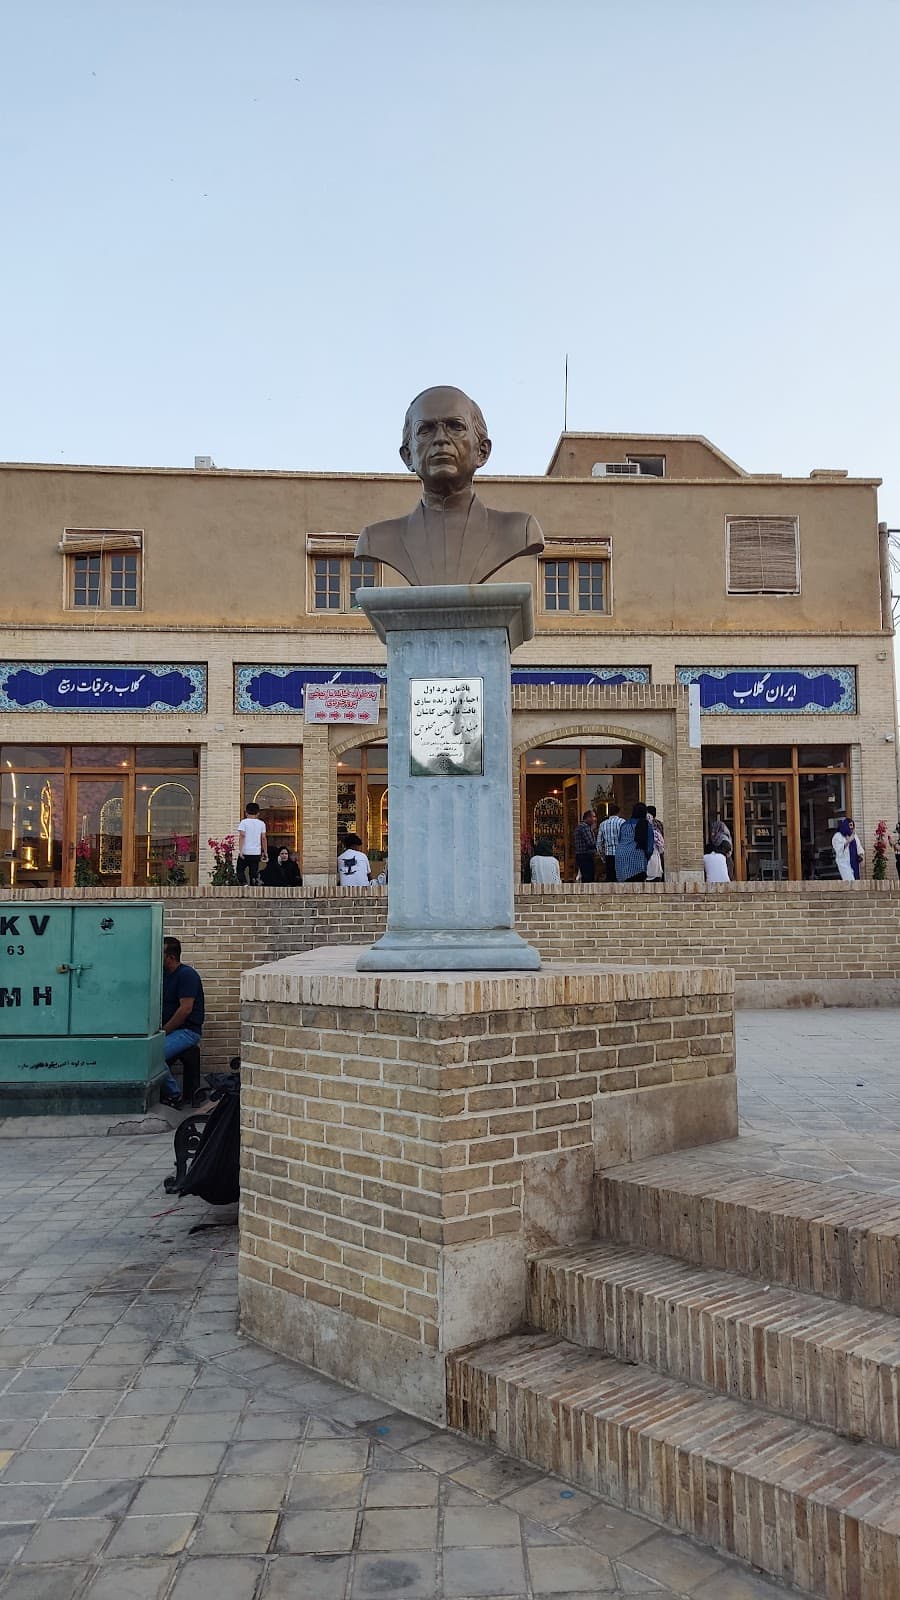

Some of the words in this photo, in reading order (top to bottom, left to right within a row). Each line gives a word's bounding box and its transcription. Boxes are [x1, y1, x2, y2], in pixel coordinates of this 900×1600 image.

[115, 674, 146, 697] گلاب
[423, 685, 435, 694] اول
[733, 672, 772, 704] گلاب
[766, 683, 797, 703] ایران
[416, 708, 435, 717] کاشان
[7, 945, 25, 956] 63
